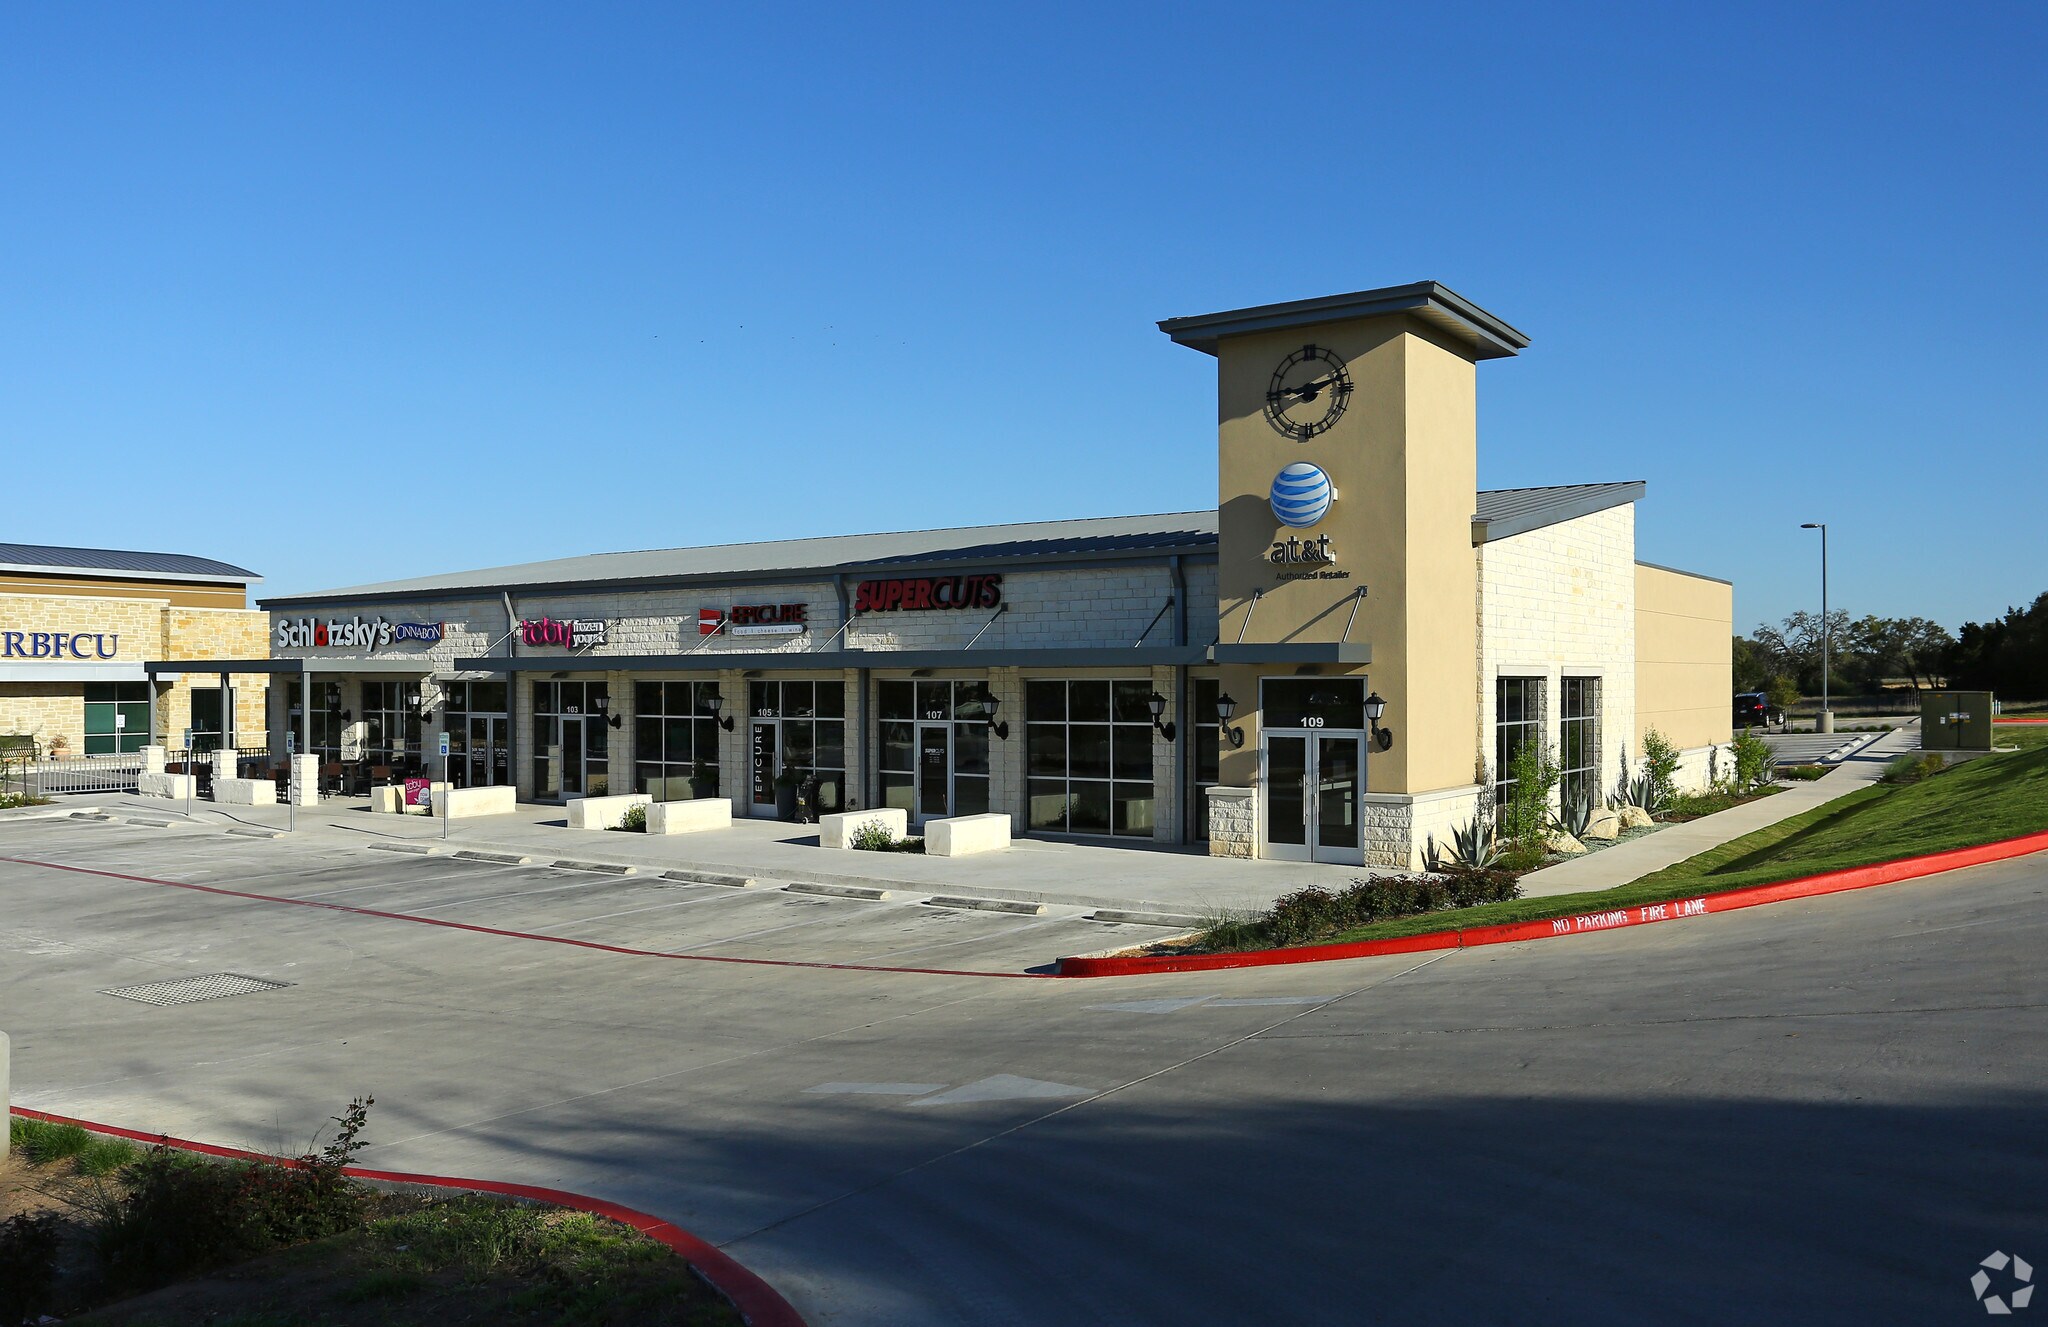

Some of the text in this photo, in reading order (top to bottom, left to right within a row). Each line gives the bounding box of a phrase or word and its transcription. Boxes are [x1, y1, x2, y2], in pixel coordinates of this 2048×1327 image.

[1270, 533, 1334, 564] at&t
[1276, 569, 1350, 580] Authorized Retailer
[854, 573, 1002, 612] SUPERCUTS
[732, 604, 808, 623] EPICURE
[276, 616, 441, 652] Schlotzsky's CINNABON
[573, 620, 604, 633] frozen
[1, 631, 119, 660] RBFCU
[566, 705, 578, 714] 103
[758, 708, 772, 717] 105
[926, 710, 943, 720] 107
[1300, 716, 1324, 728] 109
[754, 726, 763, 792] EPICURE
[1552, 898, 1709, 934] NO PARKING FIRE LANE
